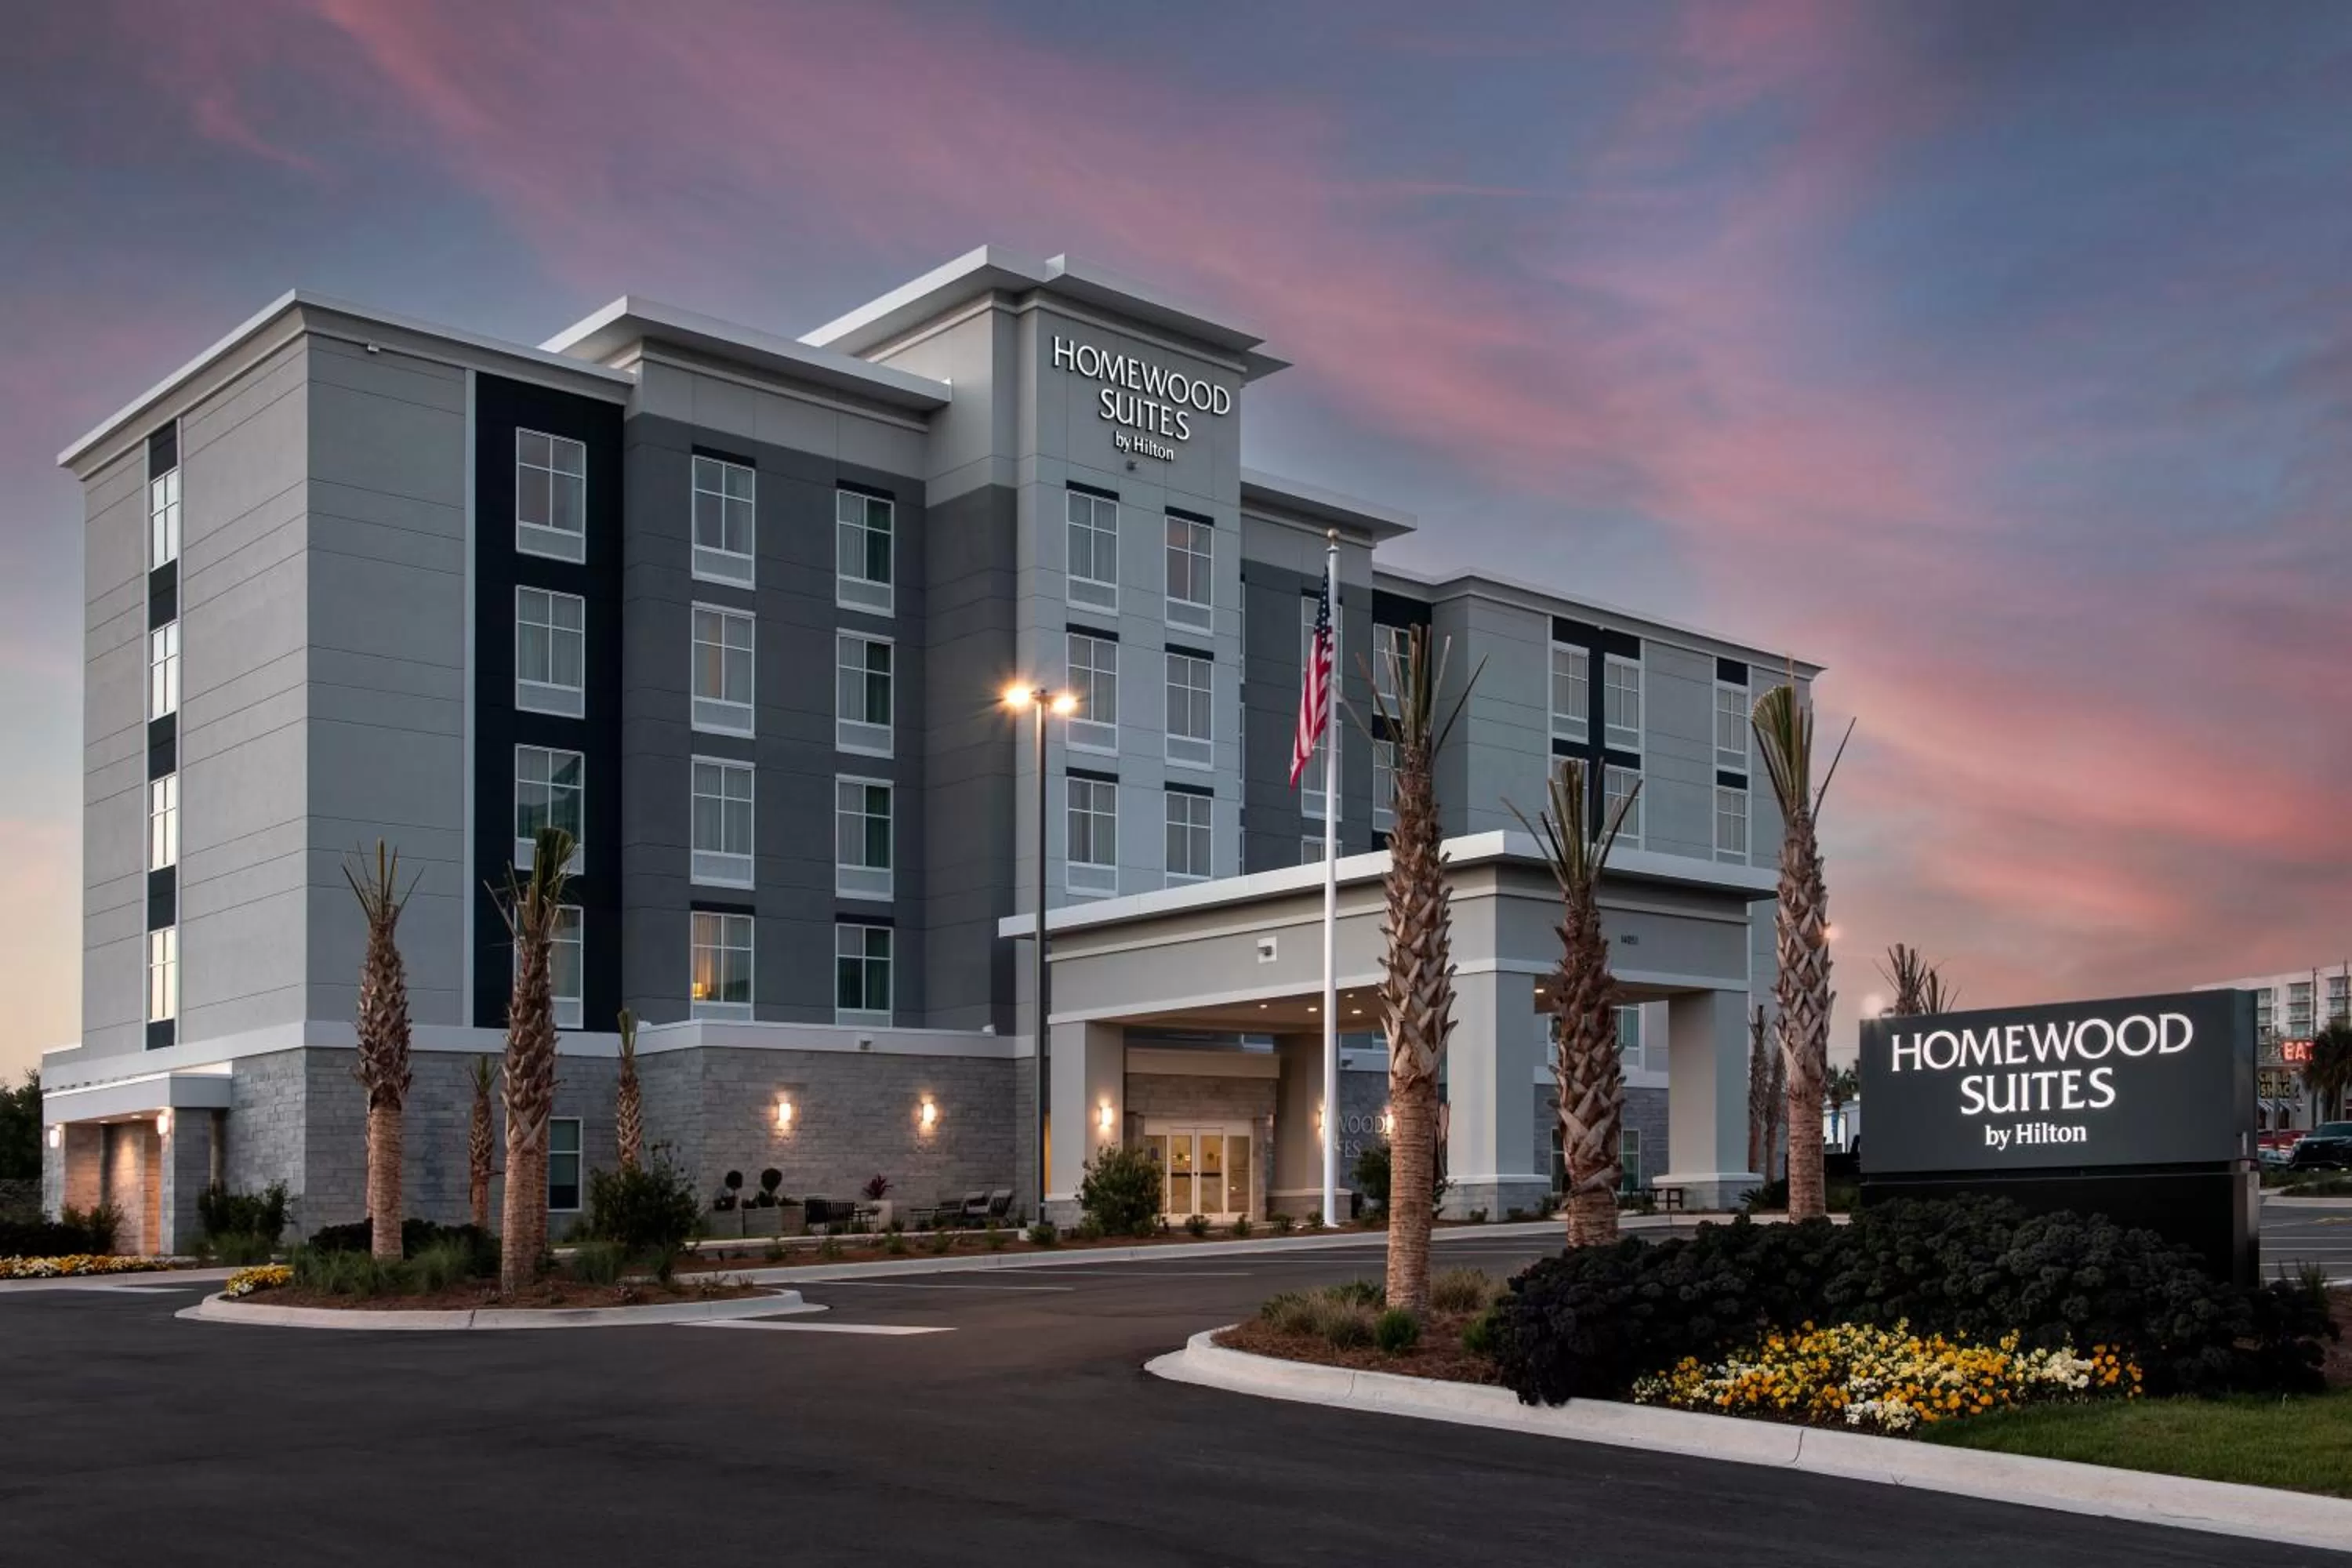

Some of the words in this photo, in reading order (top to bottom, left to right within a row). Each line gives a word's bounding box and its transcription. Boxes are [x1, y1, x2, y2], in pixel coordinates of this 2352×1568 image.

[1052, 336, 1231, 416] HOMEWOOD
[1099, 388, 1191, 441] SUITES
[1116, 431, 1131, 452] by
[1133, 436, 1174, 461] Hilton
[1892, 1014, 2194, 1072] HOMEWOOD
[1961, 1067, 2115, 1116] SUITES
[1984, 1125, 2011, 1150] by
[2015, 1122, 2087, 1145] Hilton
